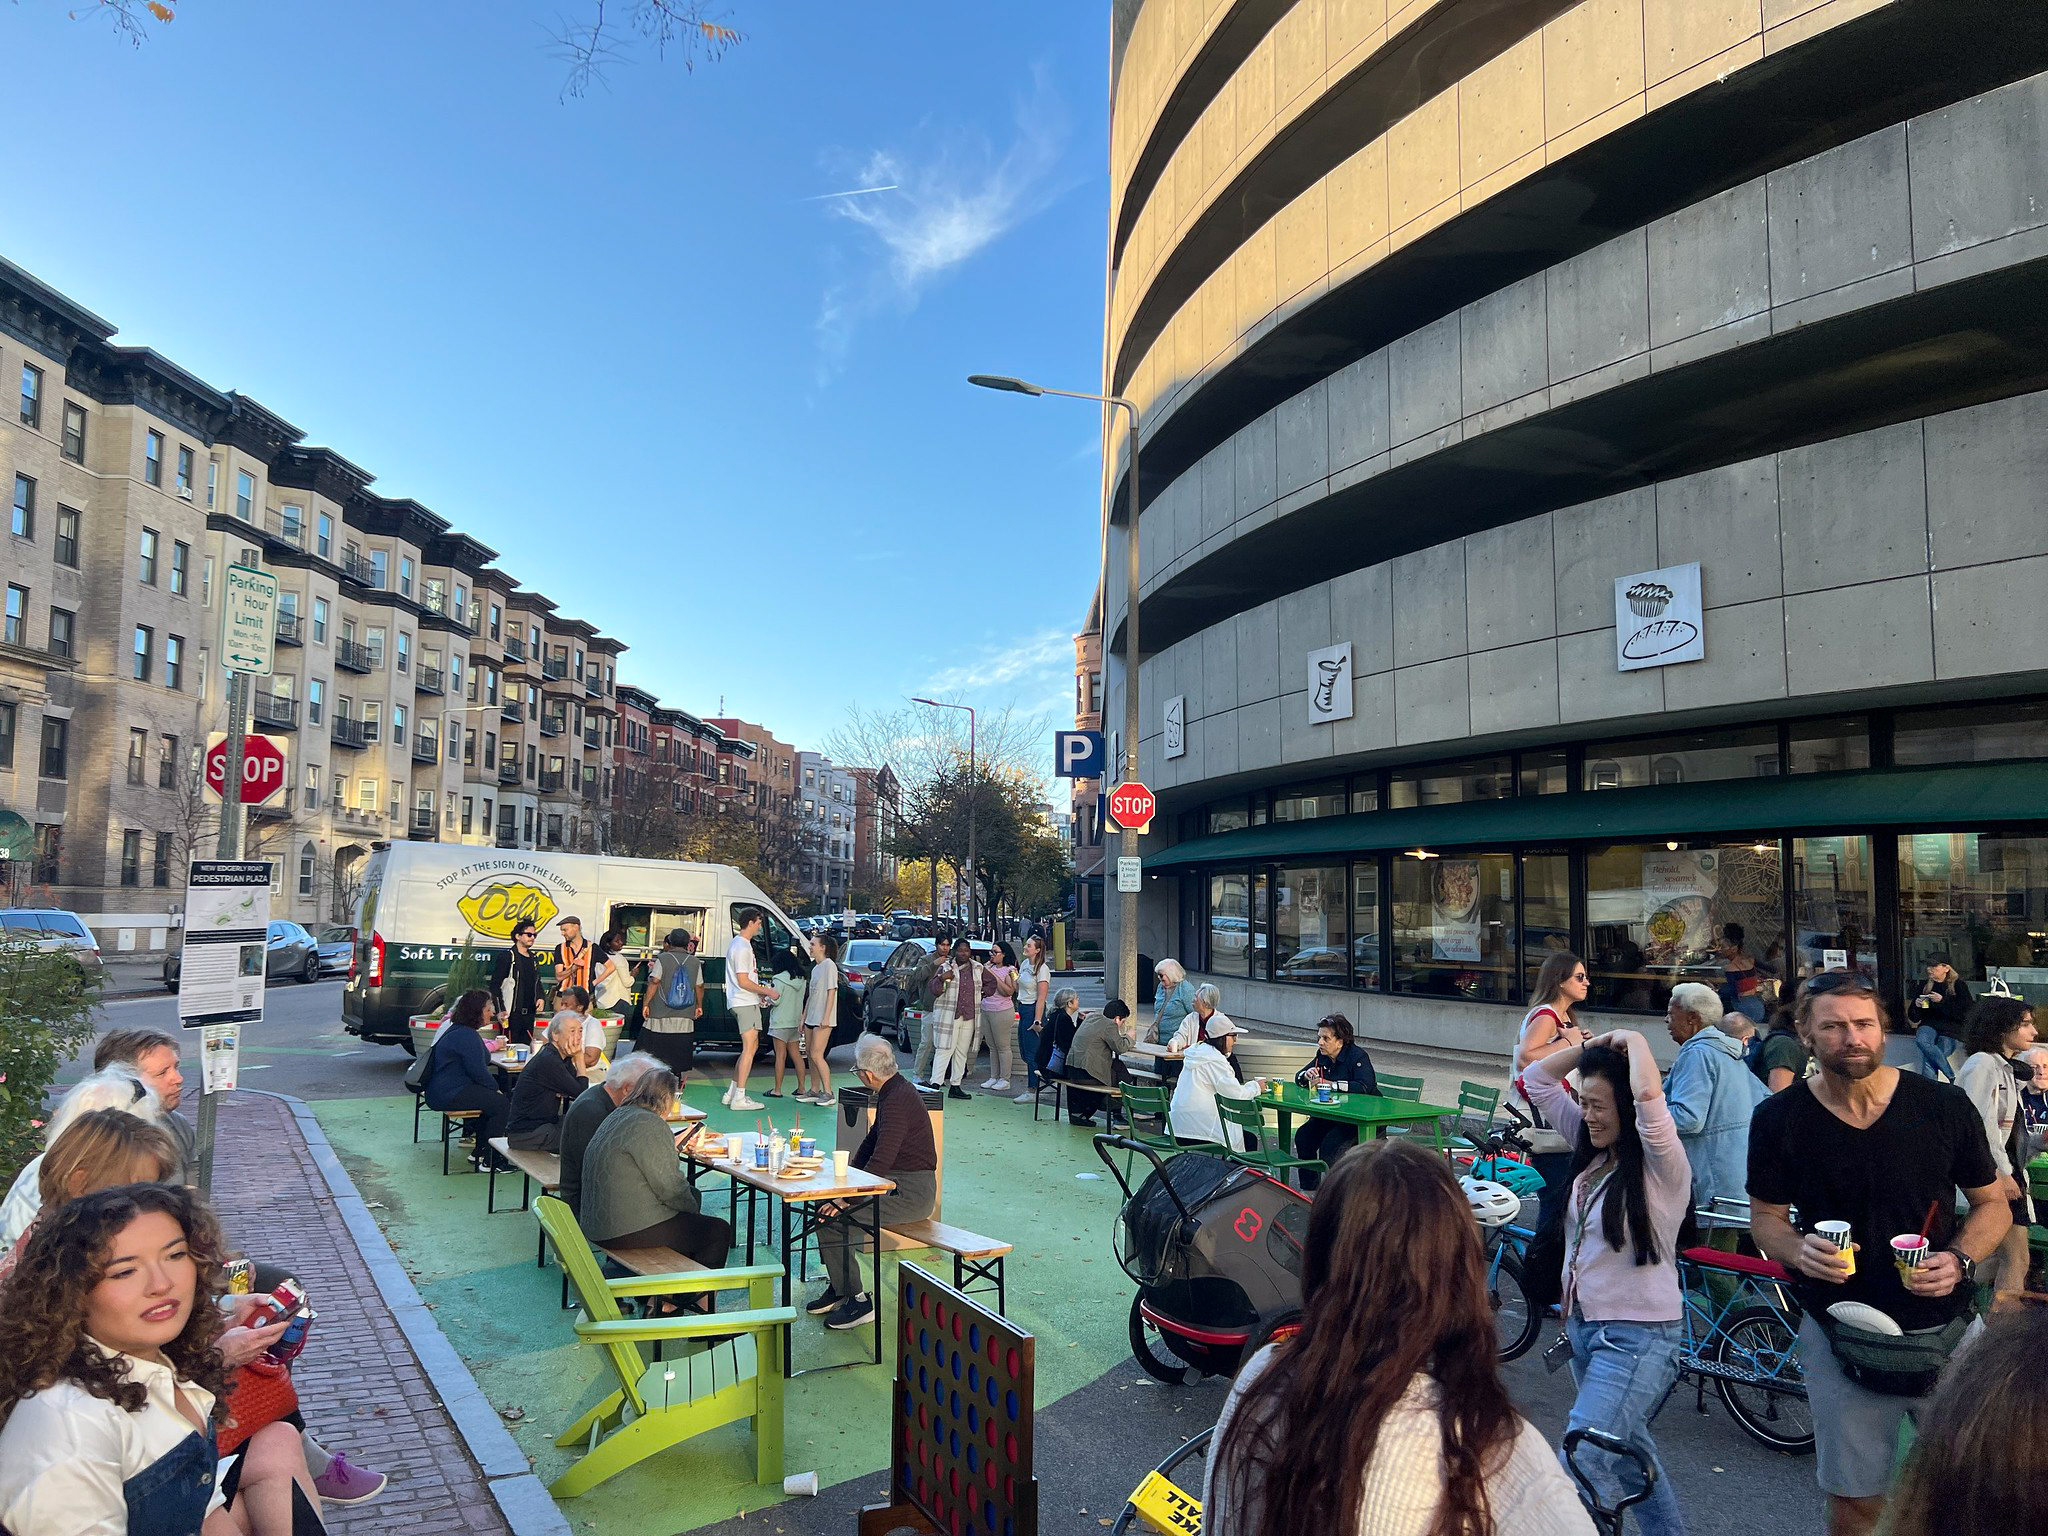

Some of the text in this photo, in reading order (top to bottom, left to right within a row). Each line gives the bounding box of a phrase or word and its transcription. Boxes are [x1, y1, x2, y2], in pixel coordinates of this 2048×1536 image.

[229, 573, 274, 598] Parking
[231, 592, 268, 611] 1 Hour
[235, 611, 263, 629] Limit
[1063, 735, 1093, 773] P
[210, 754, 280, 783] SOP
[1113, 797, 1152, 815] STOP
[193, 875, 268, 883] PEDESTRIAN PLAZA
[436, 860, 578, 897] STOP AT THE SIGN OF THE LEMON
[400, 947, 434, 961] Soft
[1166, 1490, 1202, 1524] ALL
